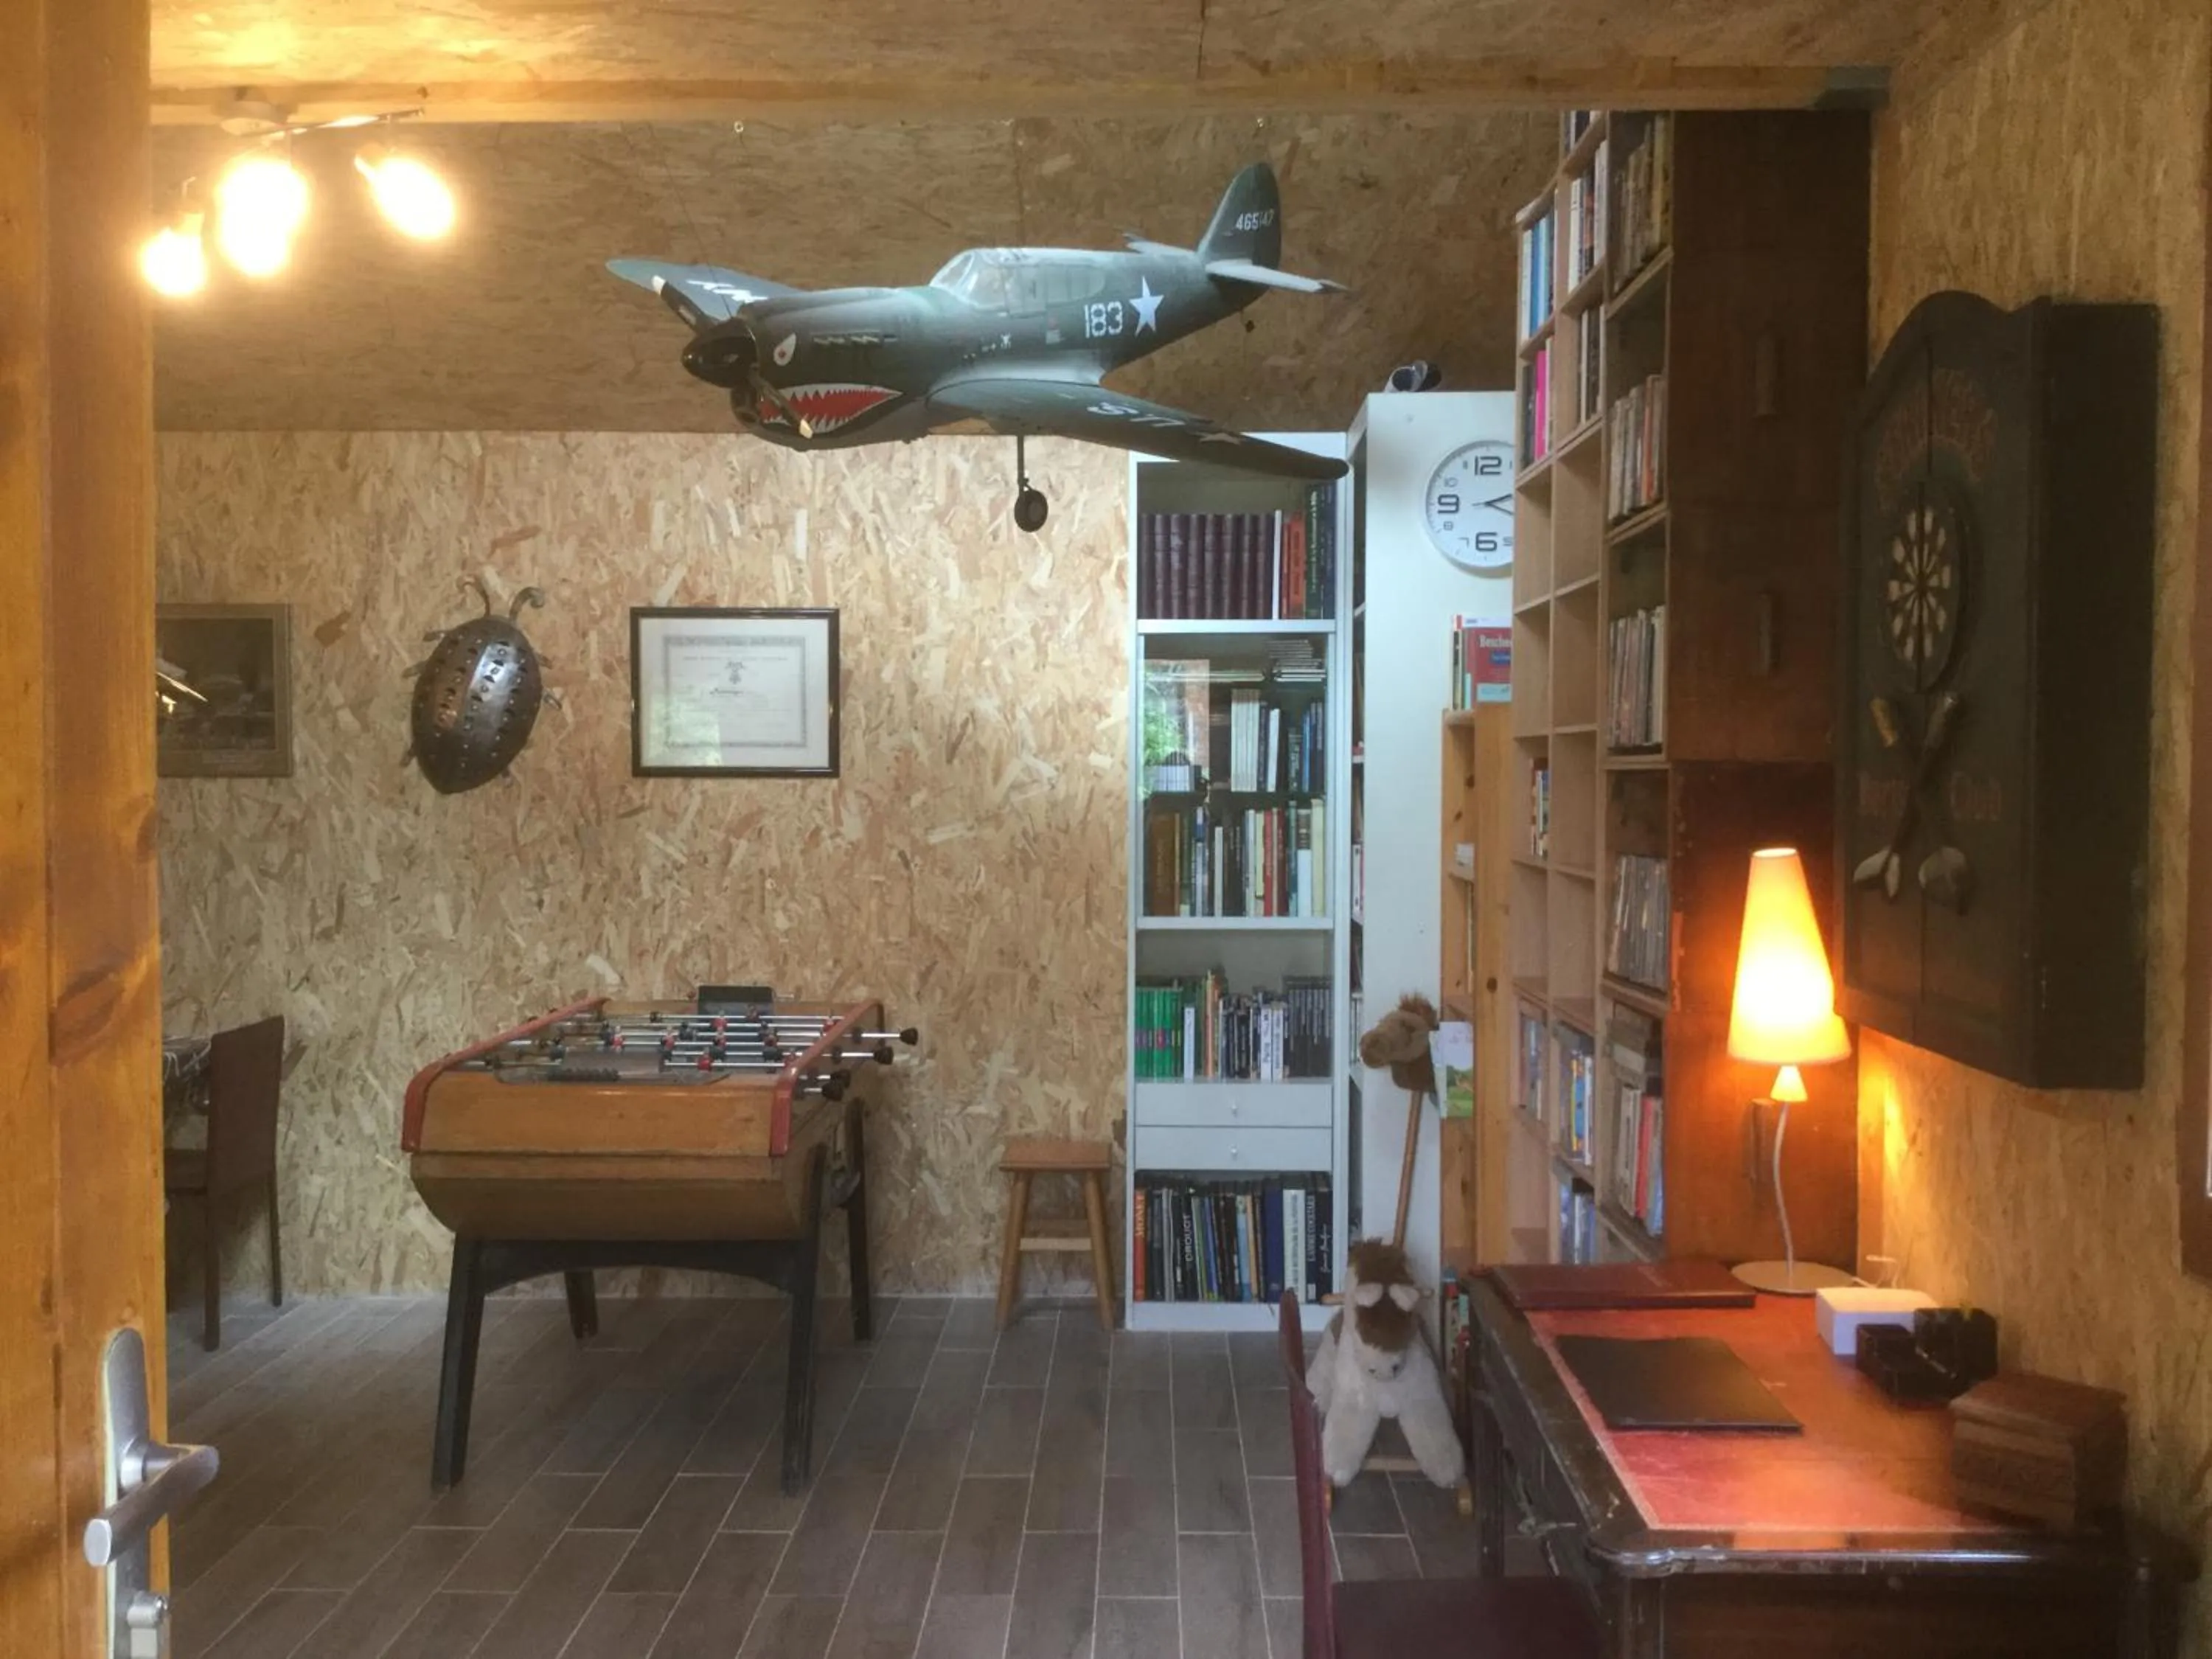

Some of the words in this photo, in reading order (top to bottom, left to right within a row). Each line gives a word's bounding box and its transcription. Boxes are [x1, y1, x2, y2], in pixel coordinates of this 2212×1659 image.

[1084, 300, 1123, 339] 183
[1474, 455, 1502, 476] 12
[1437, 493, 1461, 515] 9
[1443, 521, 1454, 531] 8
[1475, 531, 1498, 552] 6
